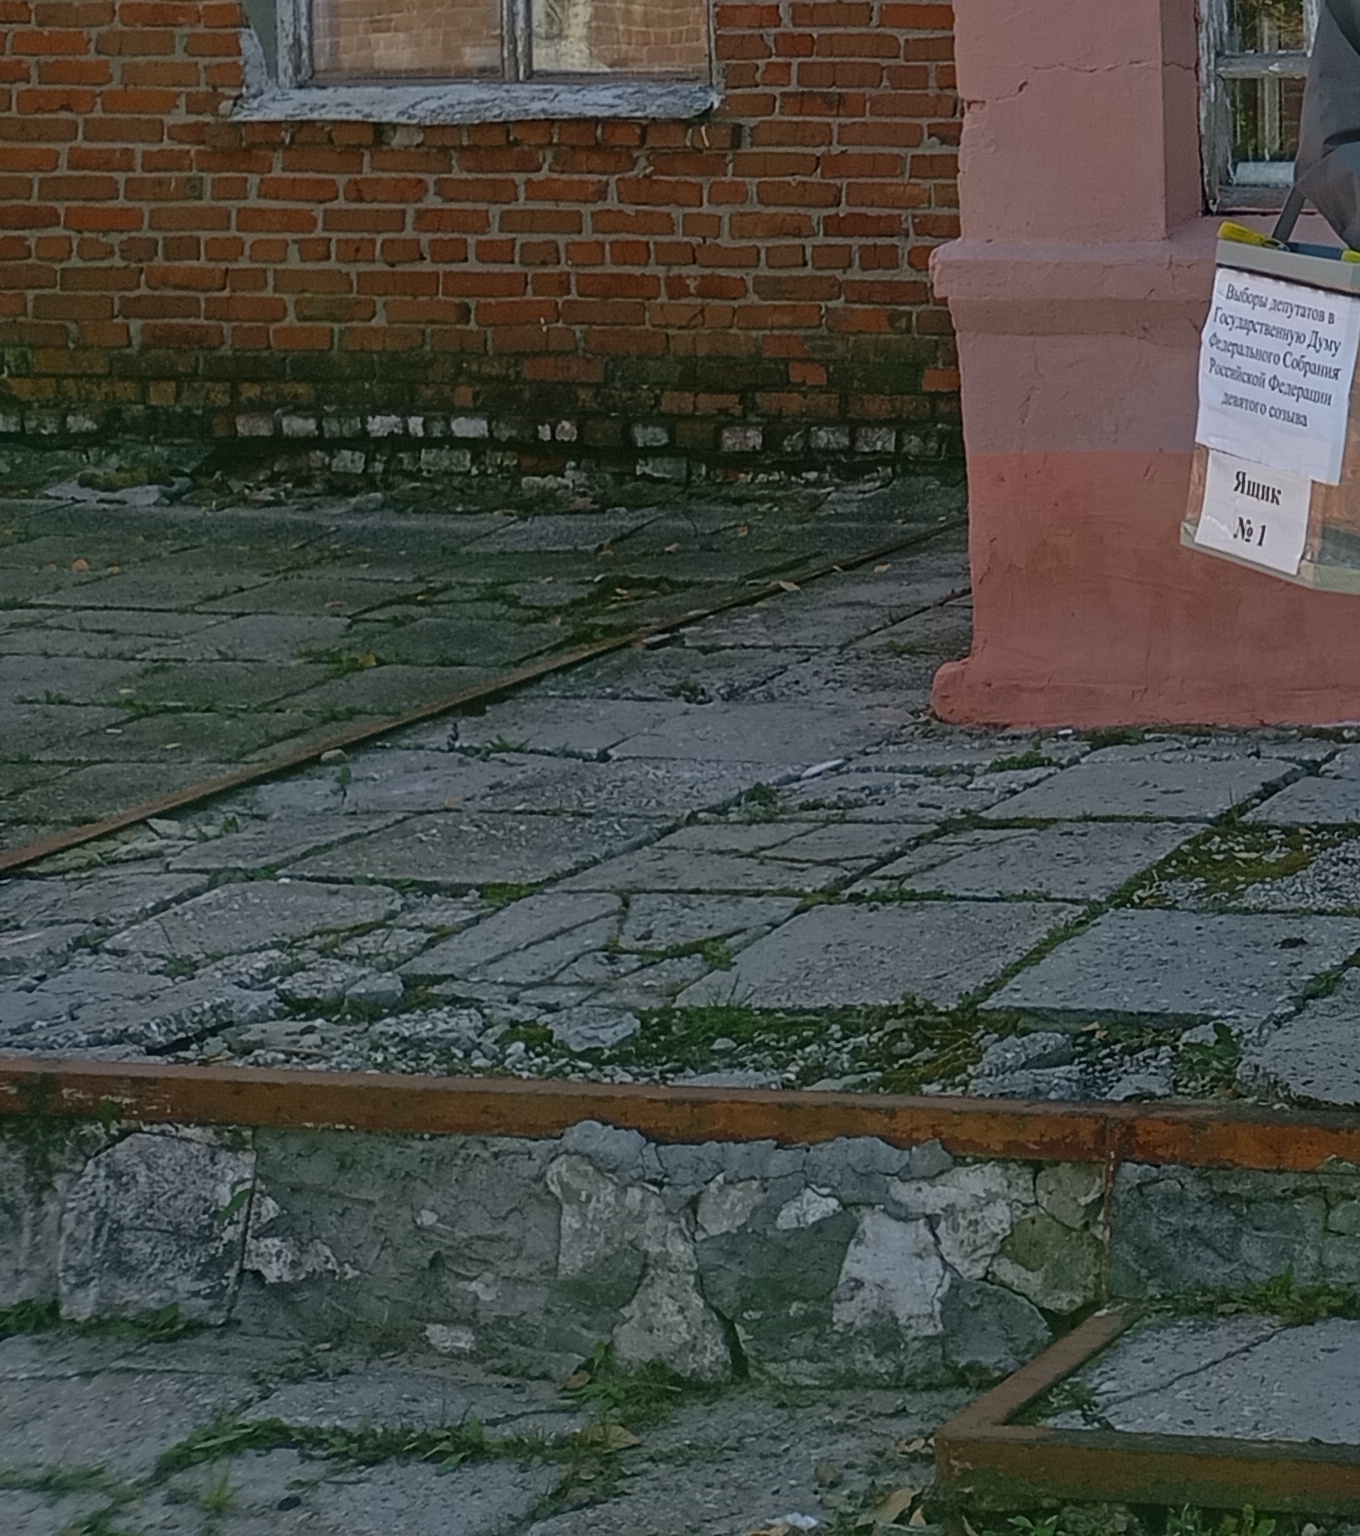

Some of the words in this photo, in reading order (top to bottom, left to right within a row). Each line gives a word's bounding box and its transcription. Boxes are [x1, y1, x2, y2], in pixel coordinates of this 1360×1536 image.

[1226, 283, 1268, 310] Выборы
[1268, 297, 1325, 323] депутатов
[1327, 312, 1336, 325] в
[1213, 307, 1306, 346] Государственную
[1306, 330, 1342, 357] Думу
[1208, 332, 1281, 365] Федерального
[1282, 351, 1342, 381] Собрания
[1208, 357, 1266, 389] Российской
[1268, 374, 1333, 406] Федерации
[1220, 392, 1267, 415] девятого
[1268, 405, 1308, 427] созыва
[1233, 470, 1282, 506] Ящик
[1233, 516, 1254, 543] №
[1257, 524, 1266, 547] 1
